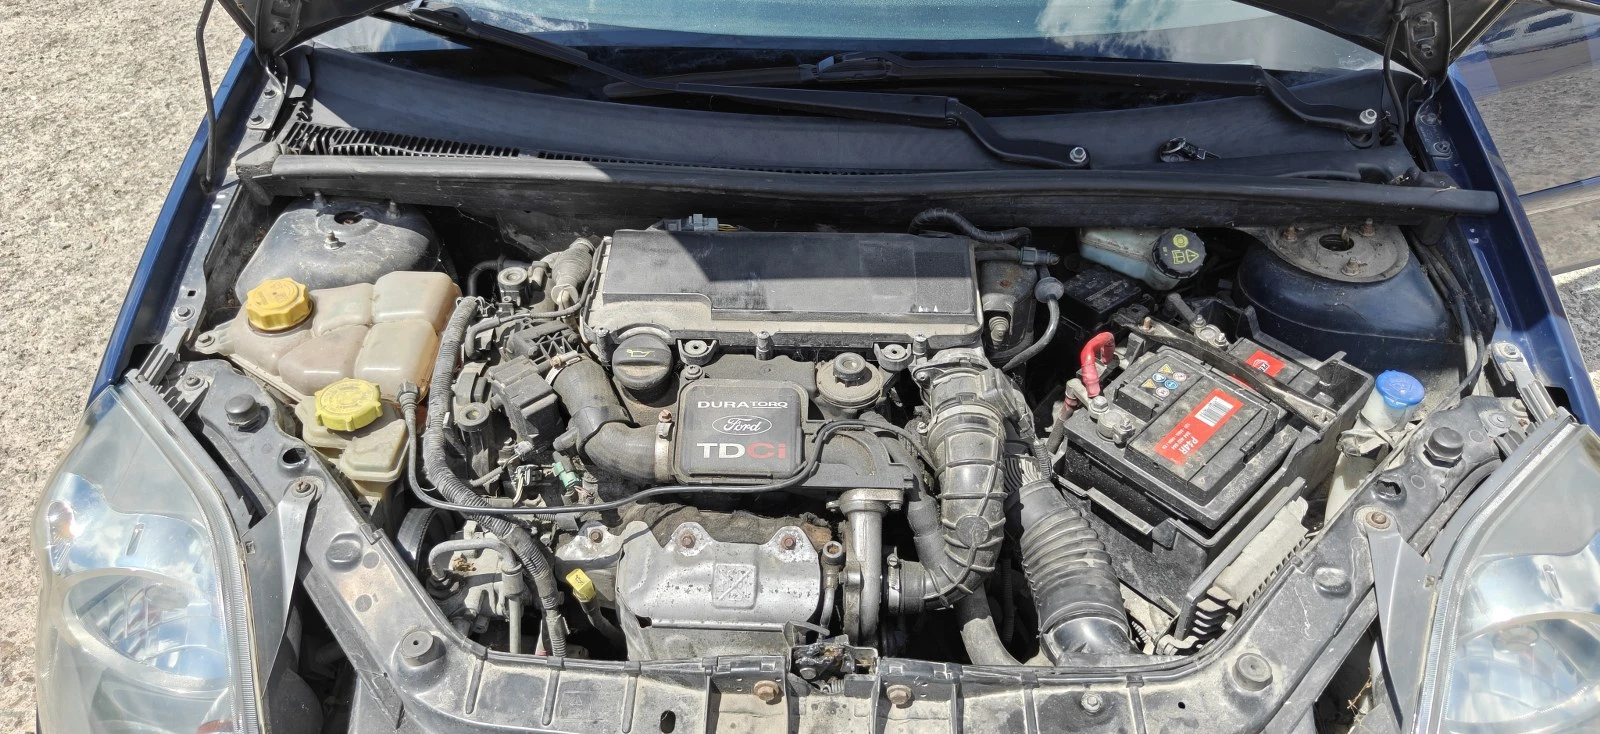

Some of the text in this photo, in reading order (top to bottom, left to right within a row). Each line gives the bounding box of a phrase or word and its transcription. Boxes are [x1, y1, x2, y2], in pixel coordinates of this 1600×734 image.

[723, 417, 762, 432] Ford
[696, 442, 787, 460] TDCi
[1178, 436, 1199, 455] P44R
